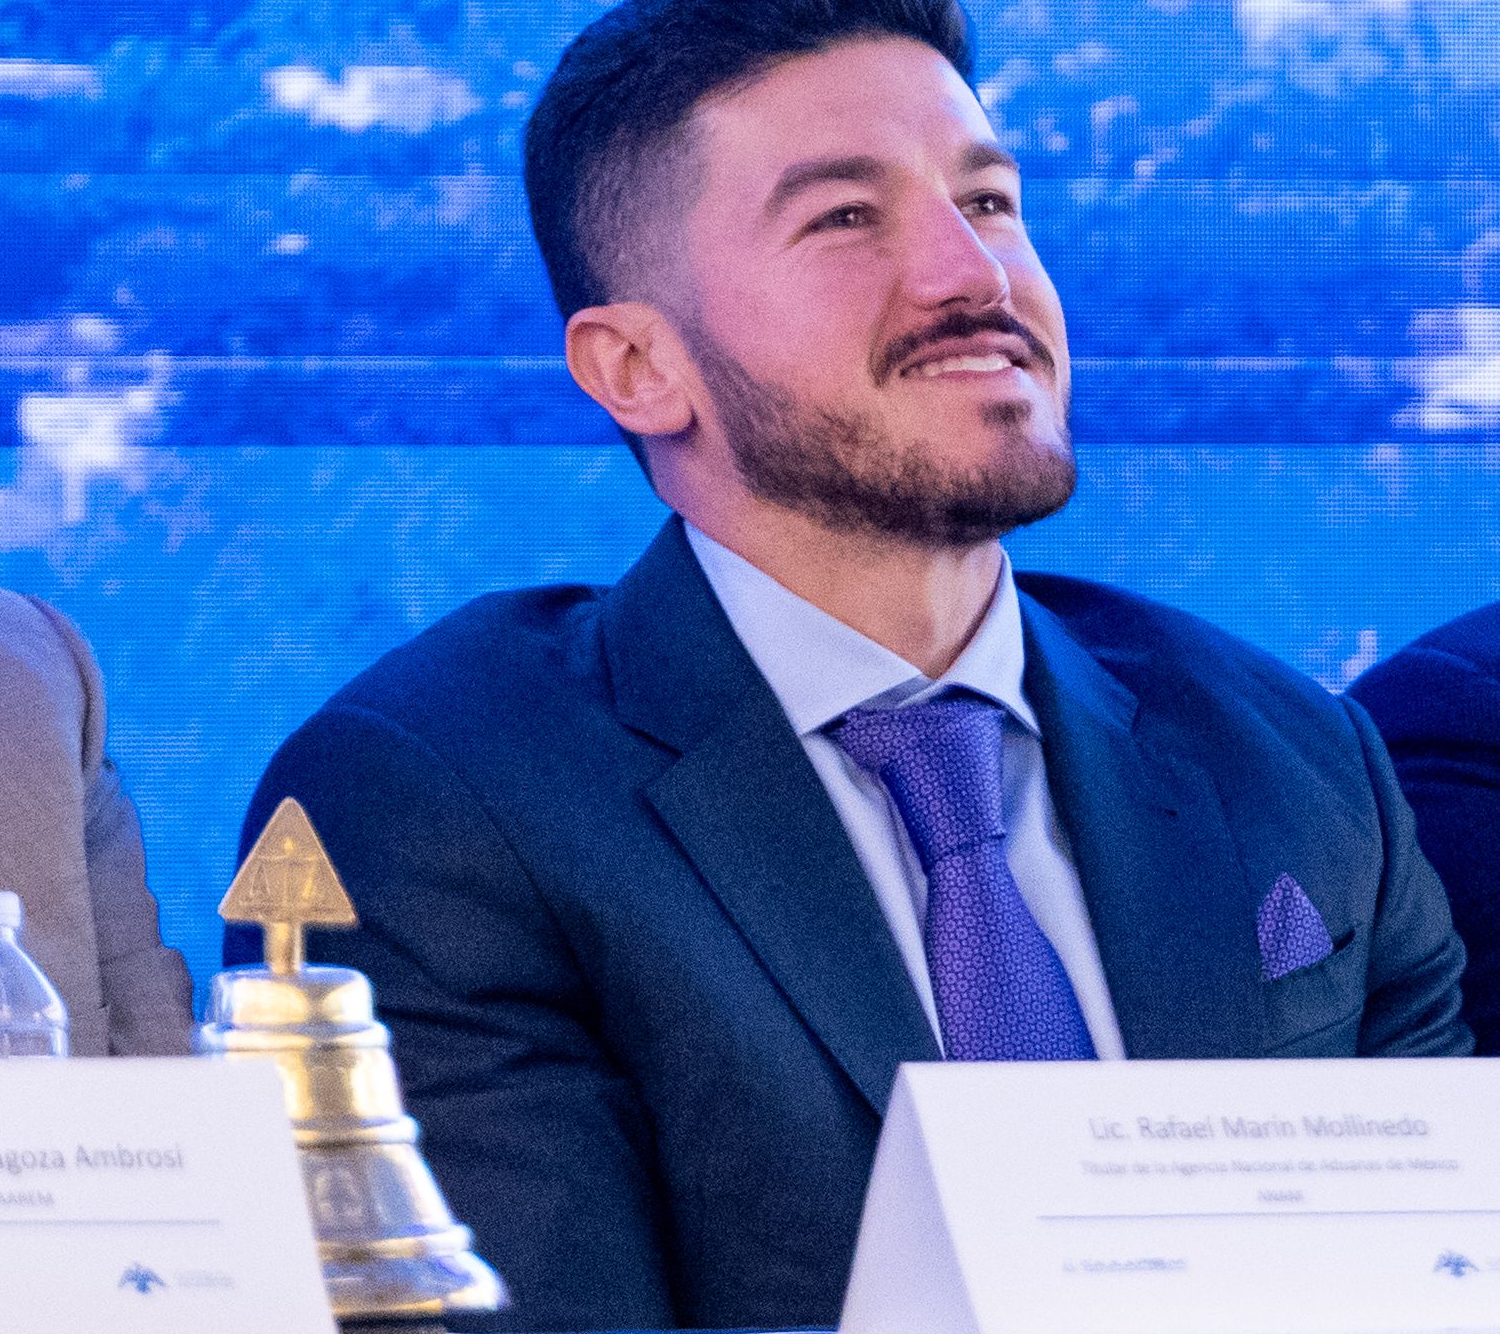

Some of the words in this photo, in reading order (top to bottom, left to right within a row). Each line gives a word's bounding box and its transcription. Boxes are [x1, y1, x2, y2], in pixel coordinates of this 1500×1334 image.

[1088, 1115, 1130, 1140] Lic.
[1136, 1114, 1215, 1139] Rafael
[1302, 1113, 1429, 1138] Mollinedo
[75, 1142, 185, 1170] Ambrosi
